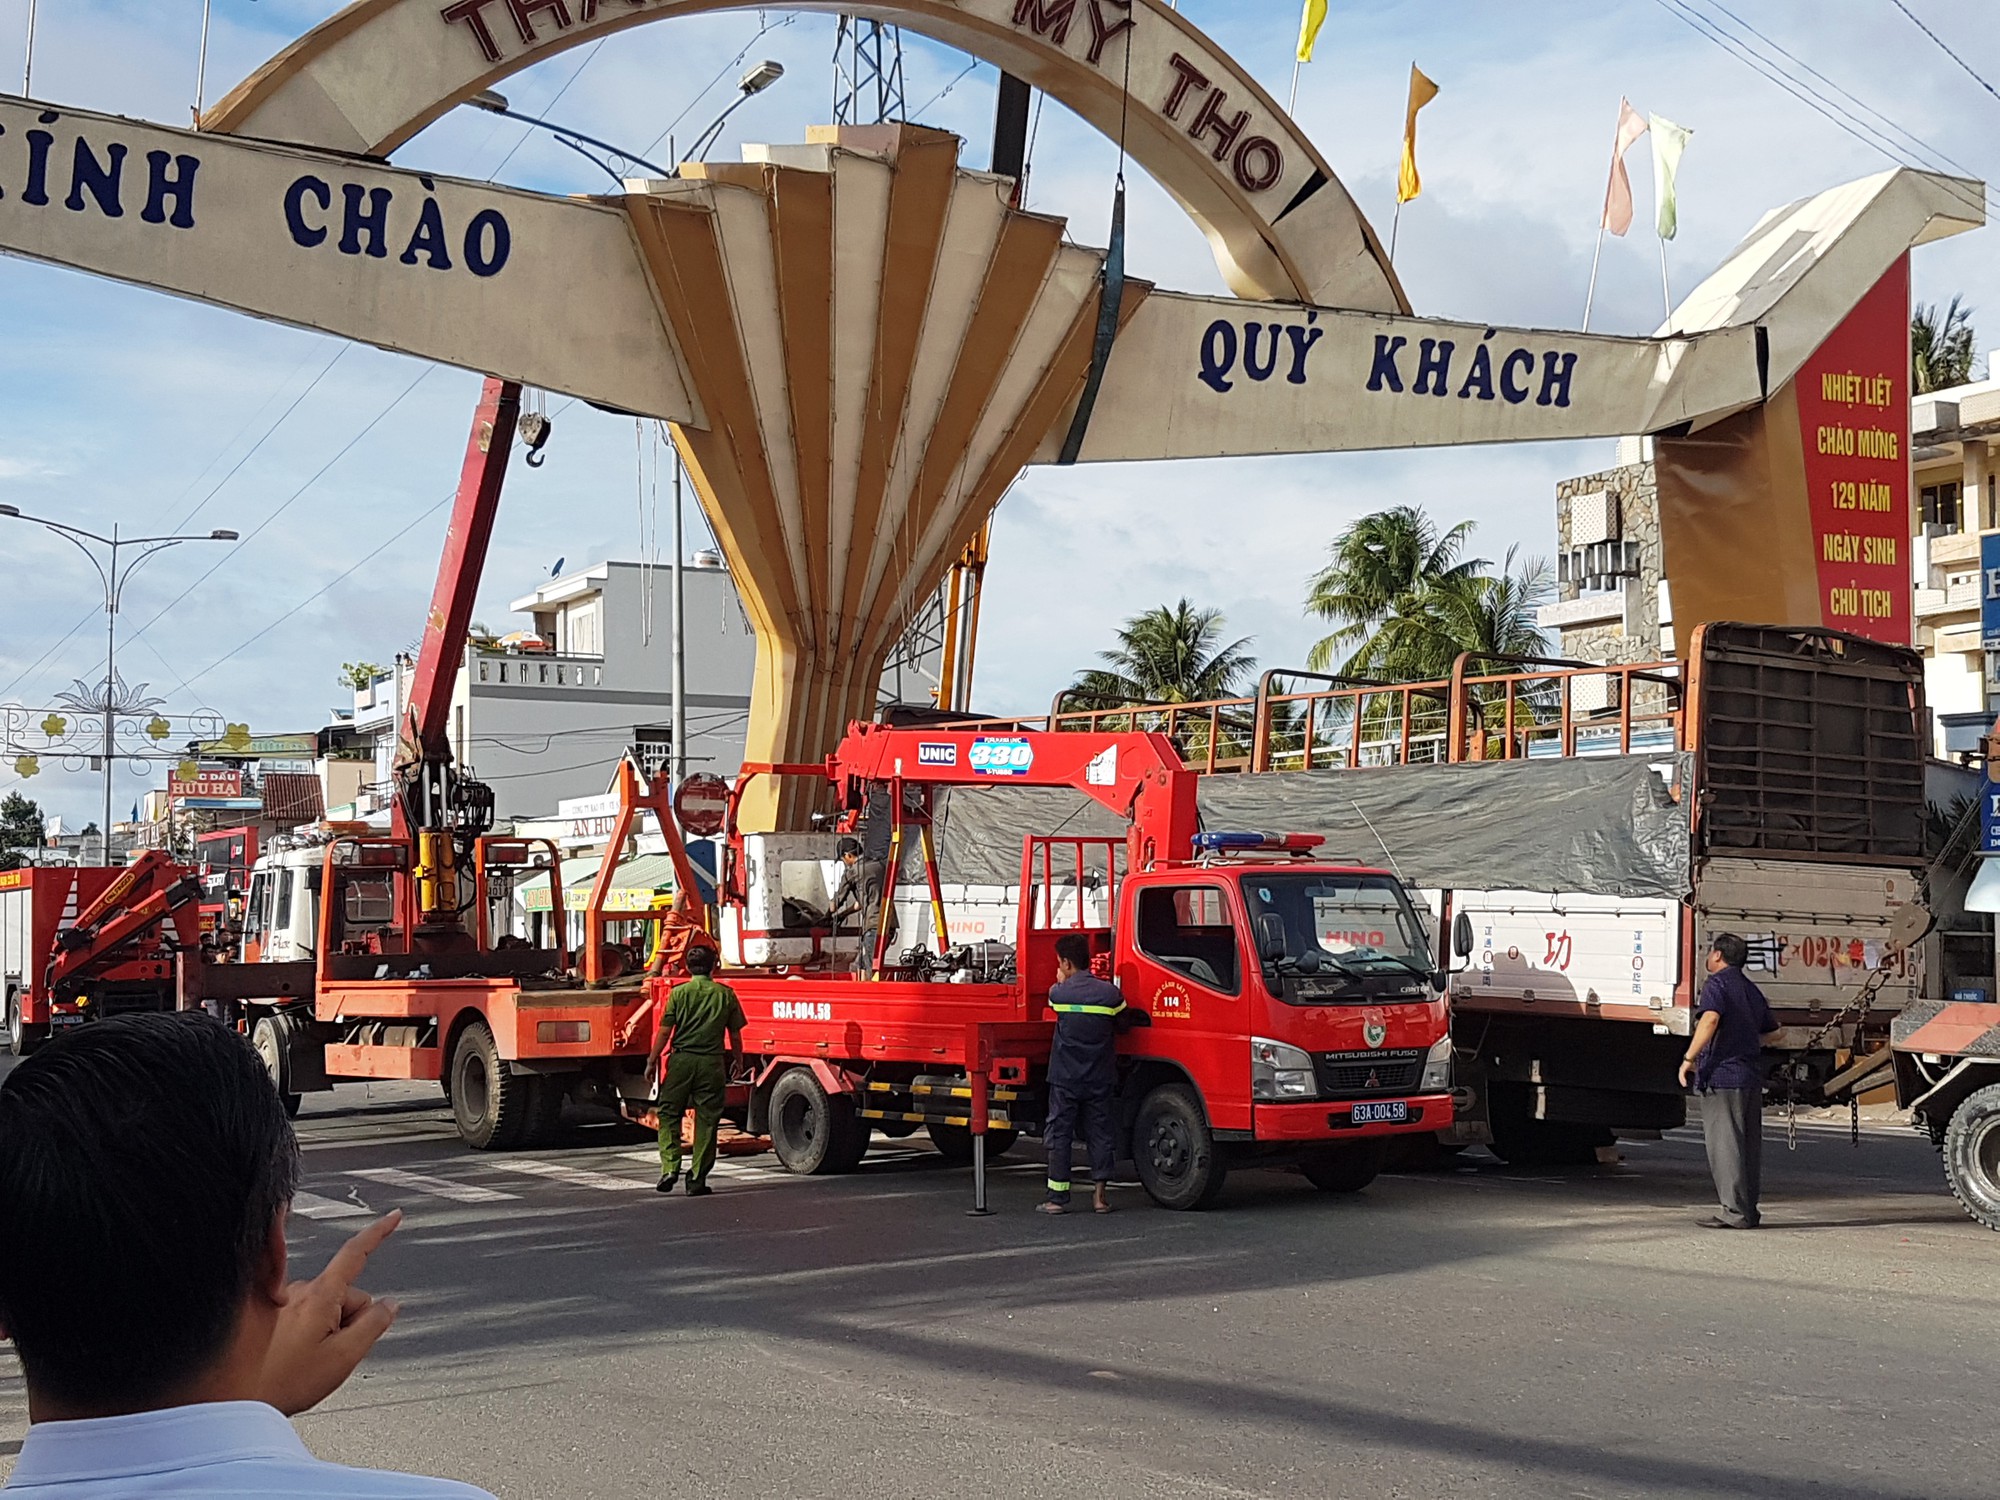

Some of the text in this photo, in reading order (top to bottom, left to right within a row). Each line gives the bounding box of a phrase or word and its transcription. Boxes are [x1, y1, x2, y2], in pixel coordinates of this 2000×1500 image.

[1163, 51, 1284, 193] THO
[0, 110, 510, 278] ÍNH CHÀO
[1198, 311, 1578, 407] QUÝ KHÁCH
[1822, 369, 1892, 412] NHIỆT LIỆT
[1817, 421, 1898, 460] CHÀO MỪNG
[1831, 478, 1891, 512] 129 NĂM
[1823, 529, 1896, 565] NGÀY SINH
[1830, 579, 1891, 623] CHỦ TỊCH
[920, 747, 955, 761] UNIC
[970, 745, 1032, 767] 330
[572, 818, 590, 838] AN
[947, 921, 985, 934] HINO
[1325, 930, 1386, 947] HINO
[1543, 929, 1572, 972] 功
[772, 1001, 832, 1020] 63A-004.58
[1163, 996, 1179, 1007] 114
[1325, 1049, 1419, 1060] MITSUBISHI FUSO
